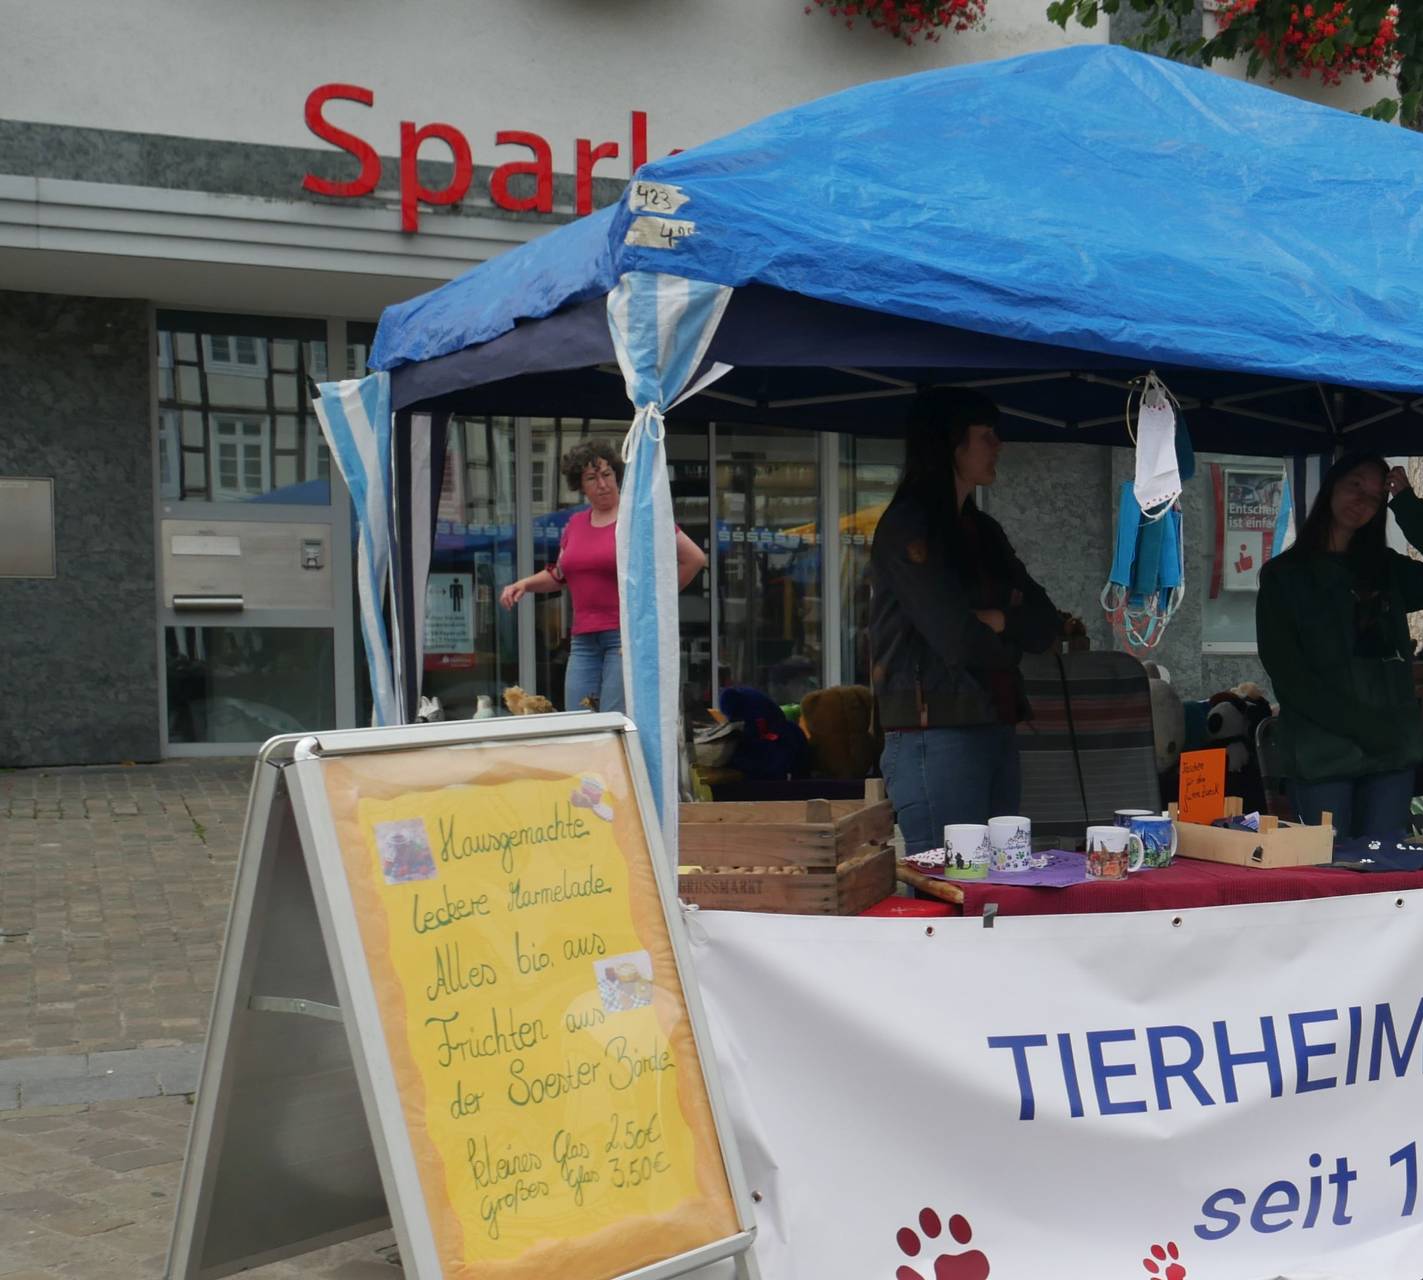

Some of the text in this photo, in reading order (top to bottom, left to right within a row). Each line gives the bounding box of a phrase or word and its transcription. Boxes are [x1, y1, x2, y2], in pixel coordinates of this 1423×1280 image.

[636, 184, 672, 210] 423
[438, 800, 590, 874] Hausgemachte
[507, 864, 612, 912] Marmelade
[427, 941, 497, 1001] Alles
[563, 933, 606, 961] aus
[425, 1007, 605, 1067] Früchten aus
[450, 1080, 485, 1119] der
[508, 1058, 600, 1106] Soester
[608, 1152, 671, 1188] 3,50€
[1193, 1153, 1358, 1241] seit
